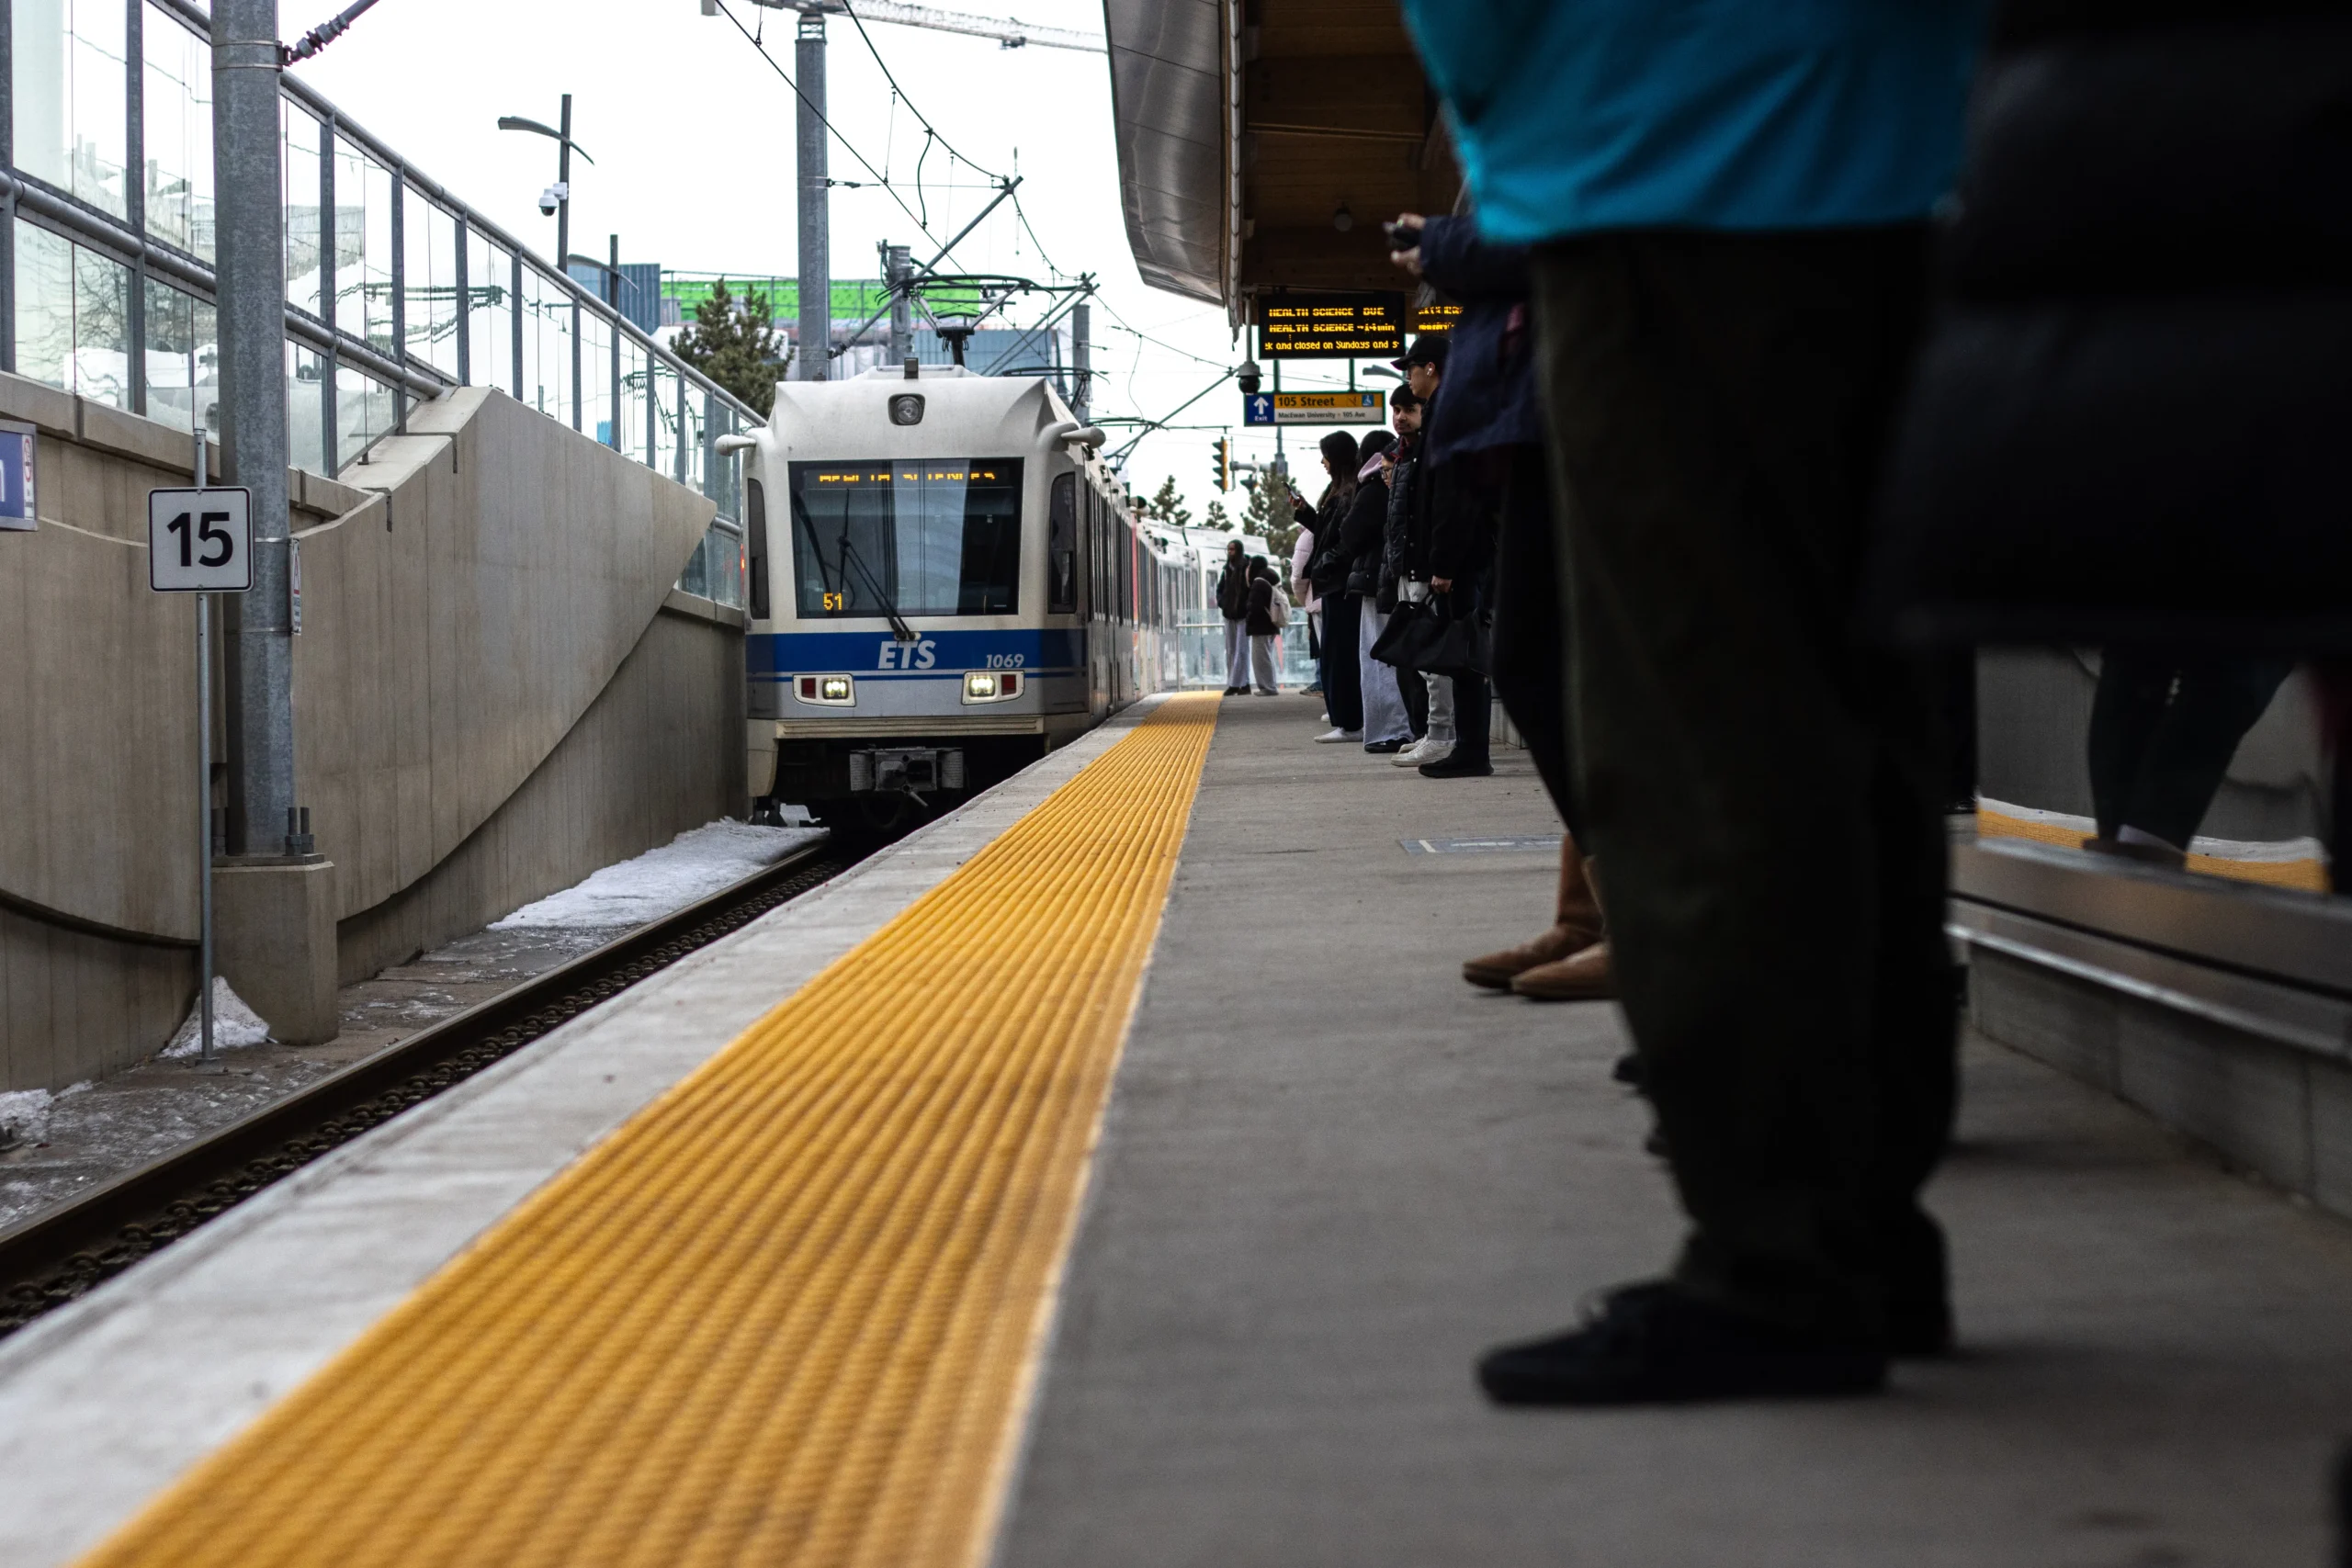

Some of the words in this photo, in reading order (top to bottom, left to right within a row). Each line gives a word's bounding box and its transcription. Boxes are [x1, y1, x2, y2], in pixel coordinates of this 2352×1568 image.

[1269, 309, 1309, 317] HEALTH
[1312, 308, 1354, 317] SCIENCE
[1363, 308, 1385, 316] DUE
[1269, 323, 1309, 333] HEALTH
[1313, 323, 1354, 333] SCIENCE
[1276, 341, 1292, 350] and
[1295, 341, 1320, 350] closed
[1323, 342, 1333, 350] on
[1336, 340, 1370, 349] Sundays
[1373, 341, 1388, 349] and
[1279, 397, 1296, 406] 105
[1301, 396, 1335, 406] Street
[167, 512, 233, 567] 15
[823, 592, 843, 611] 51
[877, 640, 935, 669] ETS
[986, 654, 1024, 668] 1069
